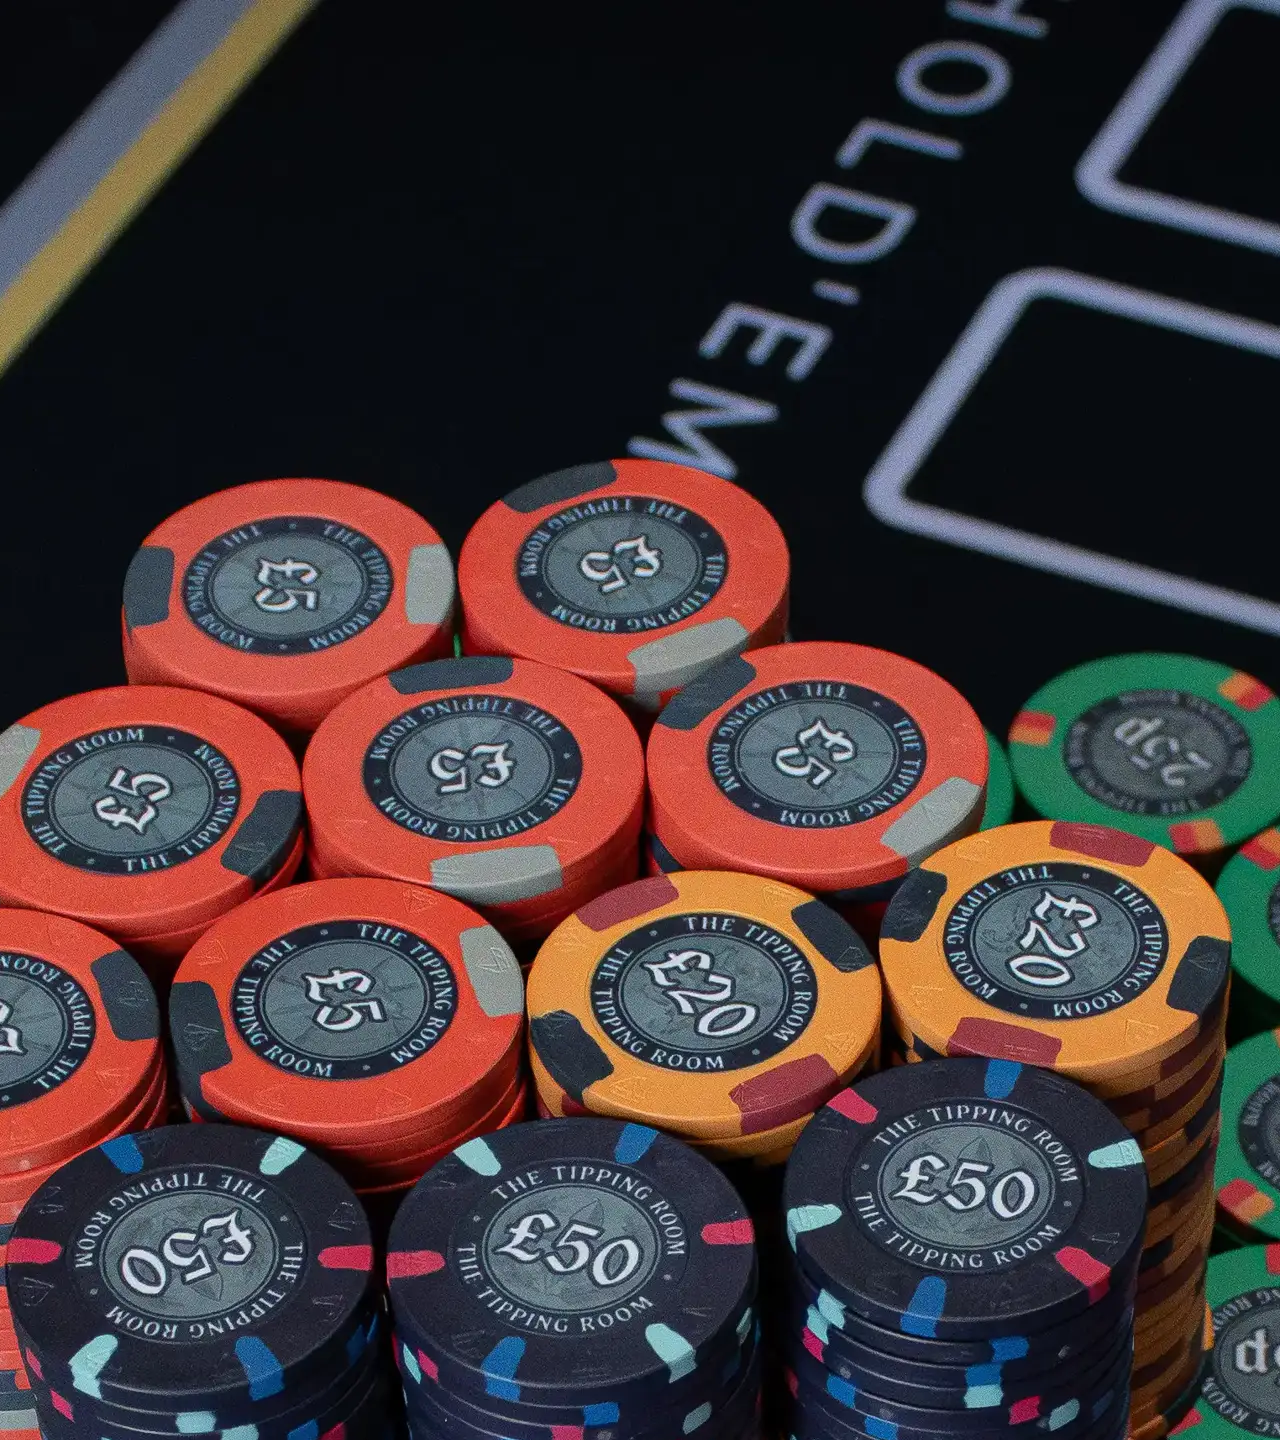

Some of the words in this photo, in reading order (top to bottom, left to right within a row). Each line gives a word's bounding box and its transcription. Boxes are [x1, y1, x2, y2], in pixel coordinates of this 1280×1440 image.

[255, 559, 318, 612] £5
[580, 536, 661, 592] £5
[420, 698, 516, 718] TIPPING
[717, 687, 790, 738] TIPPING
[801, 683, 847, 698] THE
[72, 728, 144, 754] ROOM
[371, 715, 421, 760] ROOM
[522, 709, 562, 738] THE
[892, 718, 921, 753] THE
[193, 744, 235, 791] ROOM
[430, 743, 513, 793] £5
[712, 742, 741, 792] ROOM
[775, 720, 854, 786] £5
[1113, 717, 1211, 787] 25p
[27, 752, 73, 817] TIPPING
[95, 769, 171, 832] £5
[540, 777, 574, 811] THE
[857, 759, 921, 816] TIPPING
[32, 820, 68, 854] THE
[177, 795, 235, 857] TIPPING
[379, 796, 440, 835] ROOM
[445, 810, 542, 839] TIPPING
[778, 810, 853, 826] ROOM
[122, 853, 170, 872] THE
[1004, 865, 1052, 885] THE
[685, 916, 735, 932] THE
[947, 881, 999, 945] TIPPING
[1112, 883, 1153, 916] THE
[252, 939, 296, 970] THE
[358, 924, 409, 946] THE
[743, 924, 810, 984] TIPPING
[1009, 891, 1098, 987] £20
[1123, 921, 1163, 991] TIPPING
[408, 942, 452, 1011] TIPPING
[598, 946, 633, 980] THE
[949, 950, 998, 999] ROOM
[236, 976, 269, 1047] TIPPING
[306, 969, 383, 1031] £5
[646, 950, 757, 1037] £20
[772, 990, 812, 1042] ROOM
[1052, 989, 1126, 1017] ROOM
[33, 1057, 77, 1090] THE
[56, 981, 91, 1051] TIPPING
[390, 1015, 447, 1064] ROOM
[595, 988, 646, 1054] TIPPING
[262, 1044, 333, 1077] ROOM
[648, 1048, 725, 1069] ROOM
[873, 1112, 920, 1146] THE
[926, 1103, 1032, 1131] TIPPING
[1031, 1127, 1078, 1182] ROOM
[107, 1172, 207, 1211] TIPPING
[218, 1175, 266, 1203] THE
[490, 1170, 541, 1200] THE
[551, 1165, 652, 1200] TIPPING
[647, 1198, 683, 1255] ROOM
[895, 1154, 1036, 1219] £50
[75, 1210, 112, 1268] ROOM
[121, 1211, 253, 1295] £50
[499, 1213, 640, 1286] £50
[855, 1192, 887, 1231] THE
[885, 1231, 984, 1268] TIPPING
[991, 1224, 1061, 1265] ROOM
[275, 1242, 301, 1283] THE
[188, 1288, 284, 1338] TIPPING
[457, 1243, 482, 1283] THE
[475, 1286, 568, 1333] TIPPING
[577, 1295, 653, 1332] ROOM
[104, 1305, 178, 1339] ROOM
